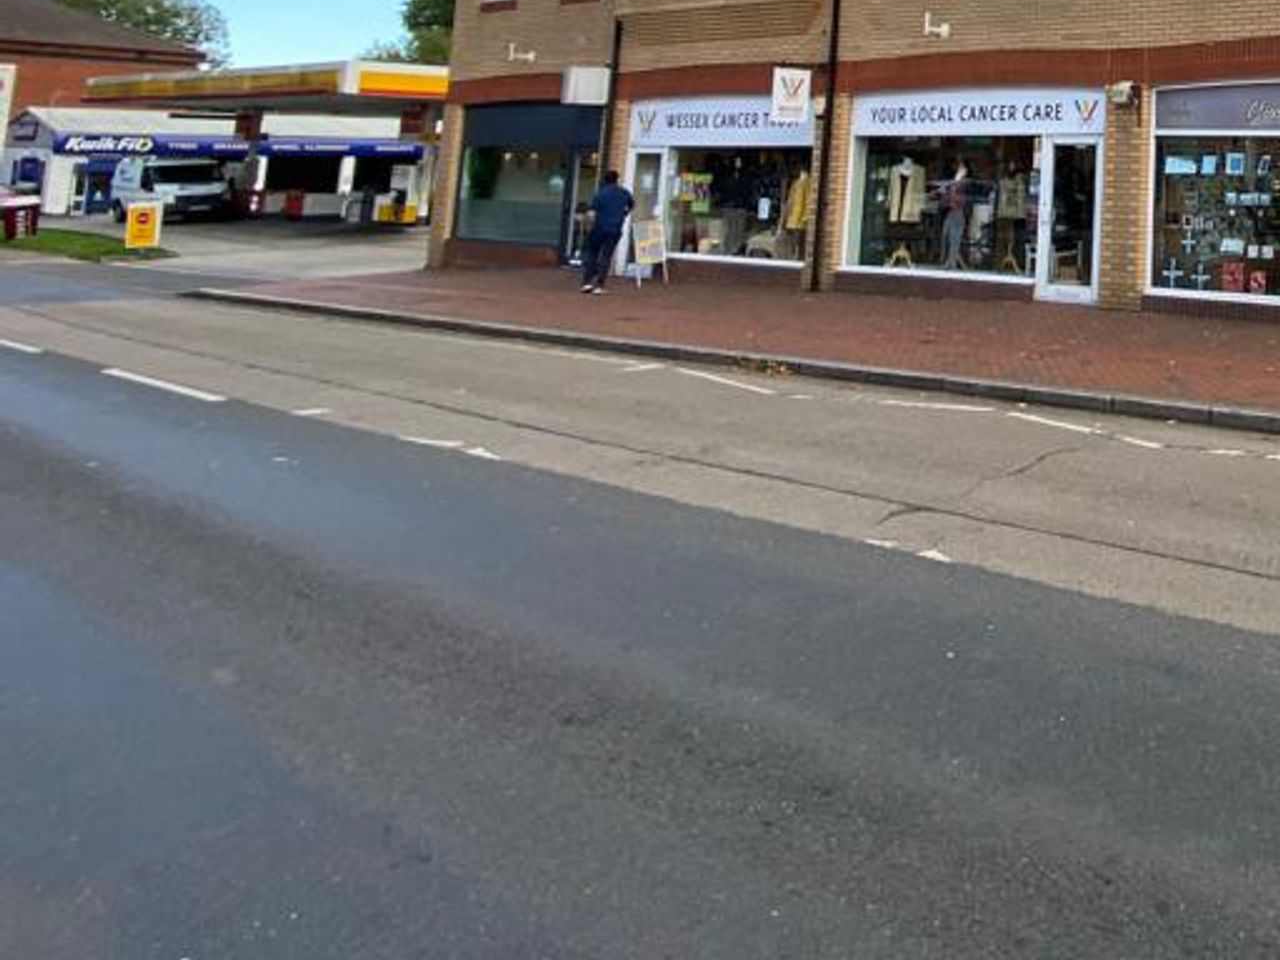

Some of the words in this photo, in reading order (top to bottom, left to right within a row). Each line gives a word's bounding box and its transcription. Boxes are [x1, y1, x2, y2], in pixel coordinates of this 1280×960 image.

[665, 112, 709, 129] WESSEX
[712, 112, 759, 129] CANCER
[870, 106, 908, 124] YOUR
[911, 105, 954, 123] LOCAL
[959, 104, 1017, 122] CANCER
[1022, 102, 1064, 122] CARE
